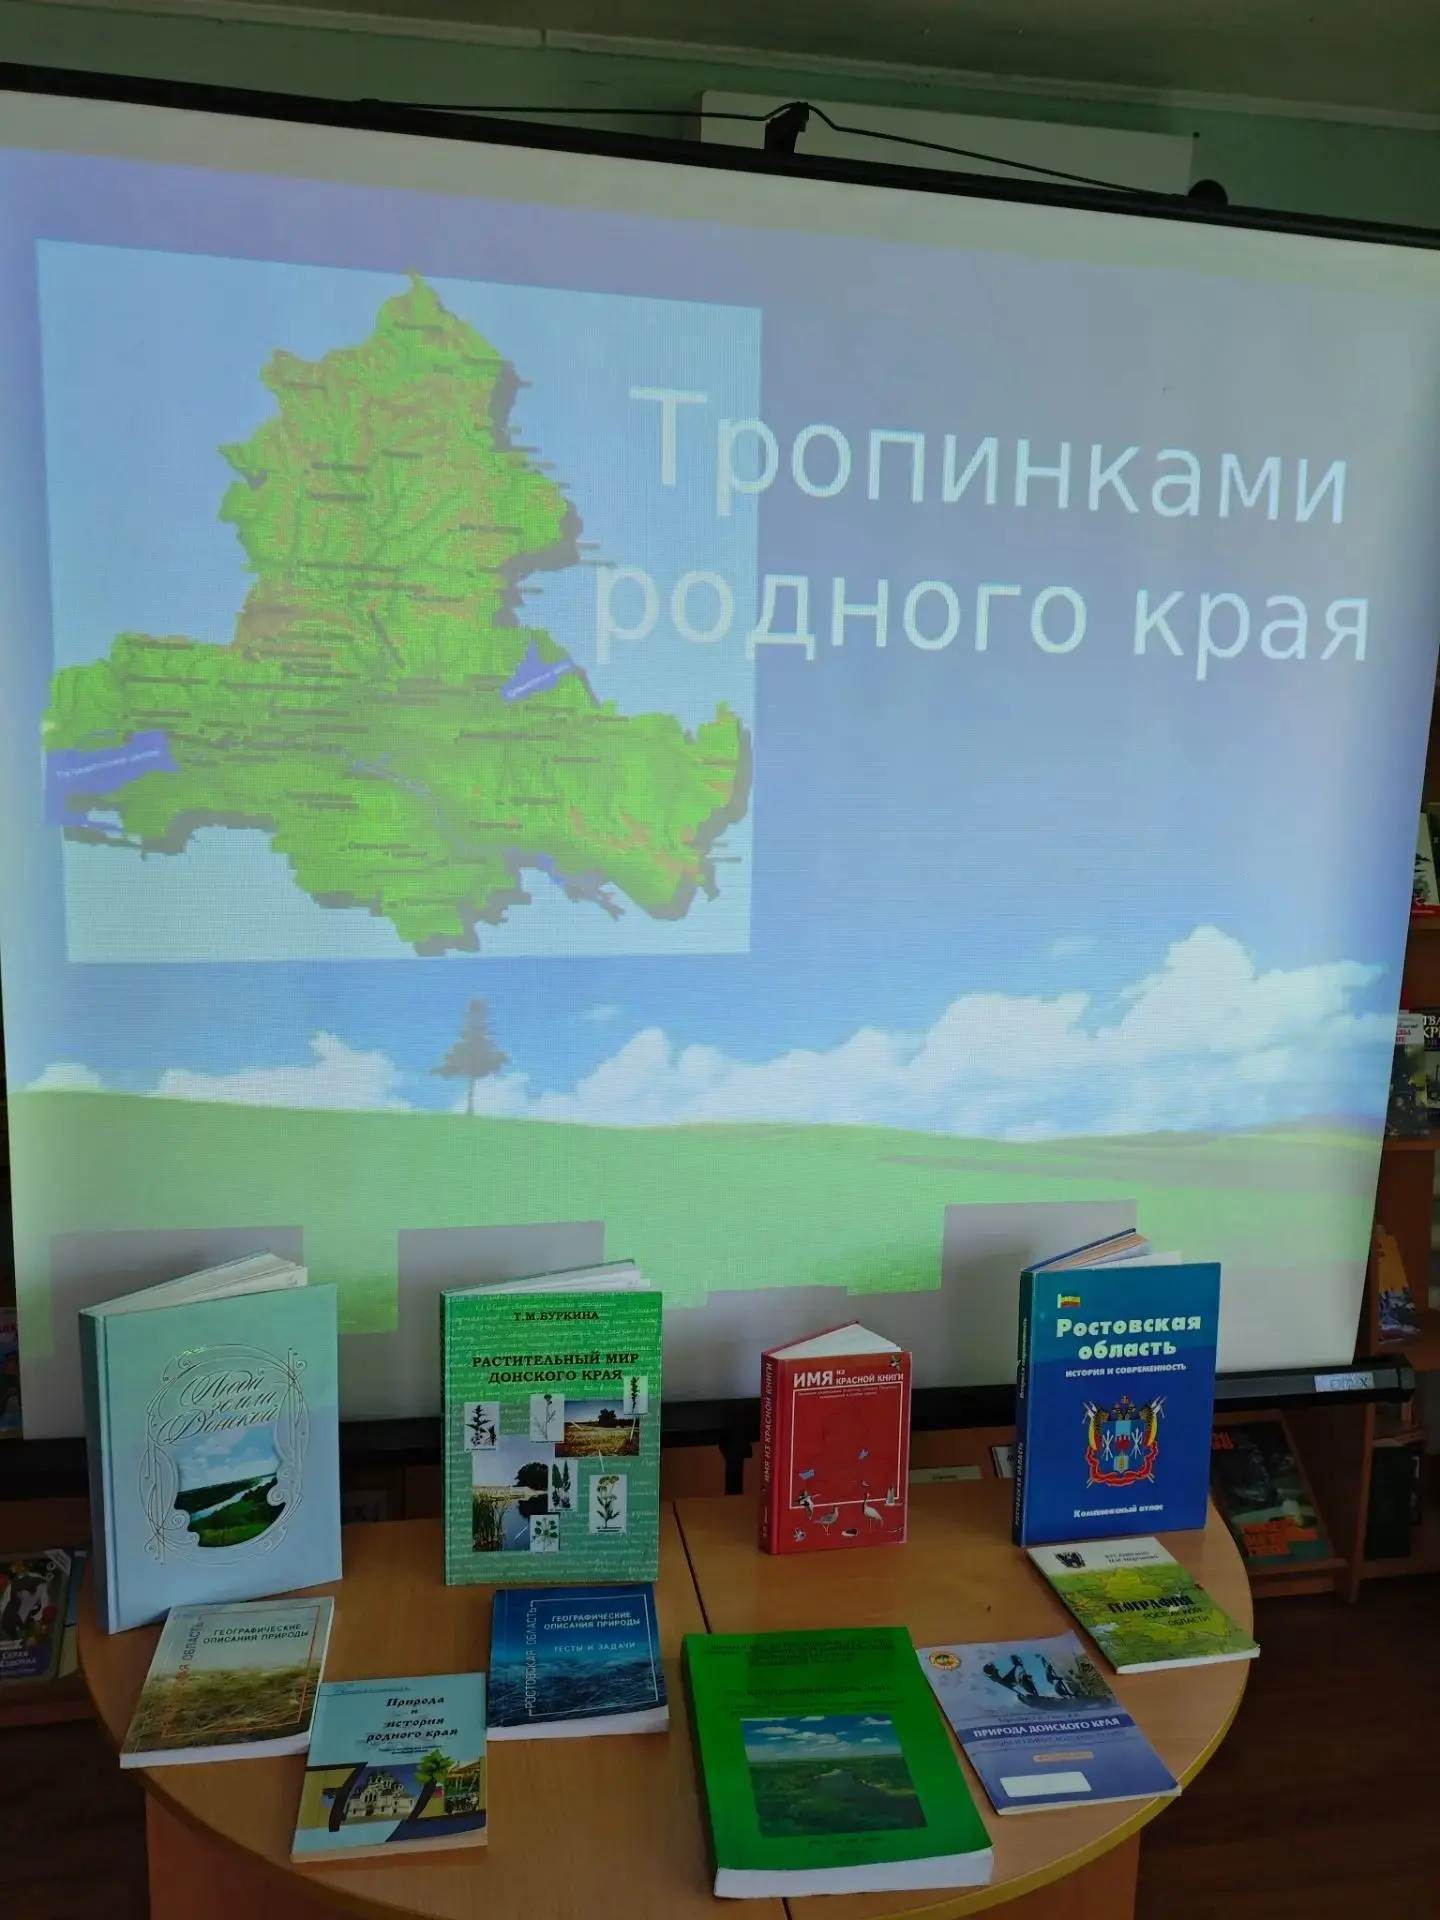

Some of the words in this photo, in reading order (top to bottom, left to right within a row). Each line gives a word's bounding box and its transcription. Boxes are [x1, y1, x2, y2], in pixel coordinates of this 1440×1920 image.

[630, 385, 1348, 524] Тропинками
[594, 566, 1088, 663] родного
[1132, 586, 1370, 681] края
[1056, 1315, 1202, 1338] Ростовская
[1078, 1339, 1177, 1361] область
[472, 1351, 600, 1368] РАСТИТЕЛЬНЫЙ
[606, 1352, 639, 1364] МИР
[488, 1369, 577, 1384] ДОНСКОГО
[582, 1368, 623, 1380] КРАЯ
[1065, 1368, 1105, 1378] ИСТОРИЯ
[1106, 1366, 1114, 1375] И
[1115, 1363, 1187, 1375] СОВРЕМЕННОСТЬ
[794, 1370, 834, 1389] ИМЯ
[836, 1374, 875, 1385] КРАСНОЙ
[877, 1373, 904, 1382] КНИГИ
[544, 1621, 594, 1630] ОПИСАНИЯ
[596, 1618, 641, 1628] ПРИРОДЫ
[552, 1611, 632, 1622] ГЕОГРАФИЧЕСКИЕ
[213, 1623, 302, 1636] ГЕОГРАФИЧЕСКИЕ
[526, 1606, 538, 1645] ОБЛАСТЬ
[182, 1620, 204, 1661] ОБЛАСТЬ
[203, 1634, 257, 1644] ОПИСАНИЯ
[260, 1629, 309, 1641] ПРИРОДЫ
[554, 1645, 583, 1653] ТЕСТЫ
[598, 1642, 636, 1651] ЗАДАЧИ
[525, 1650, 537, 1709] РОСТОВСКАЯ
[385, 1696, 445, 1708] Природа
[384, 1717, 445, 1729] история
[973, 1726, 1028, 1738] ПРИРОДА
[1028, 1719, 1090, 1735] ДОНСКОГО
[1091, 1717, 1121, 1728] КРАЯ
[366, 1731, 422, 1744] родного
[425, 1728, 458, 1740] края
